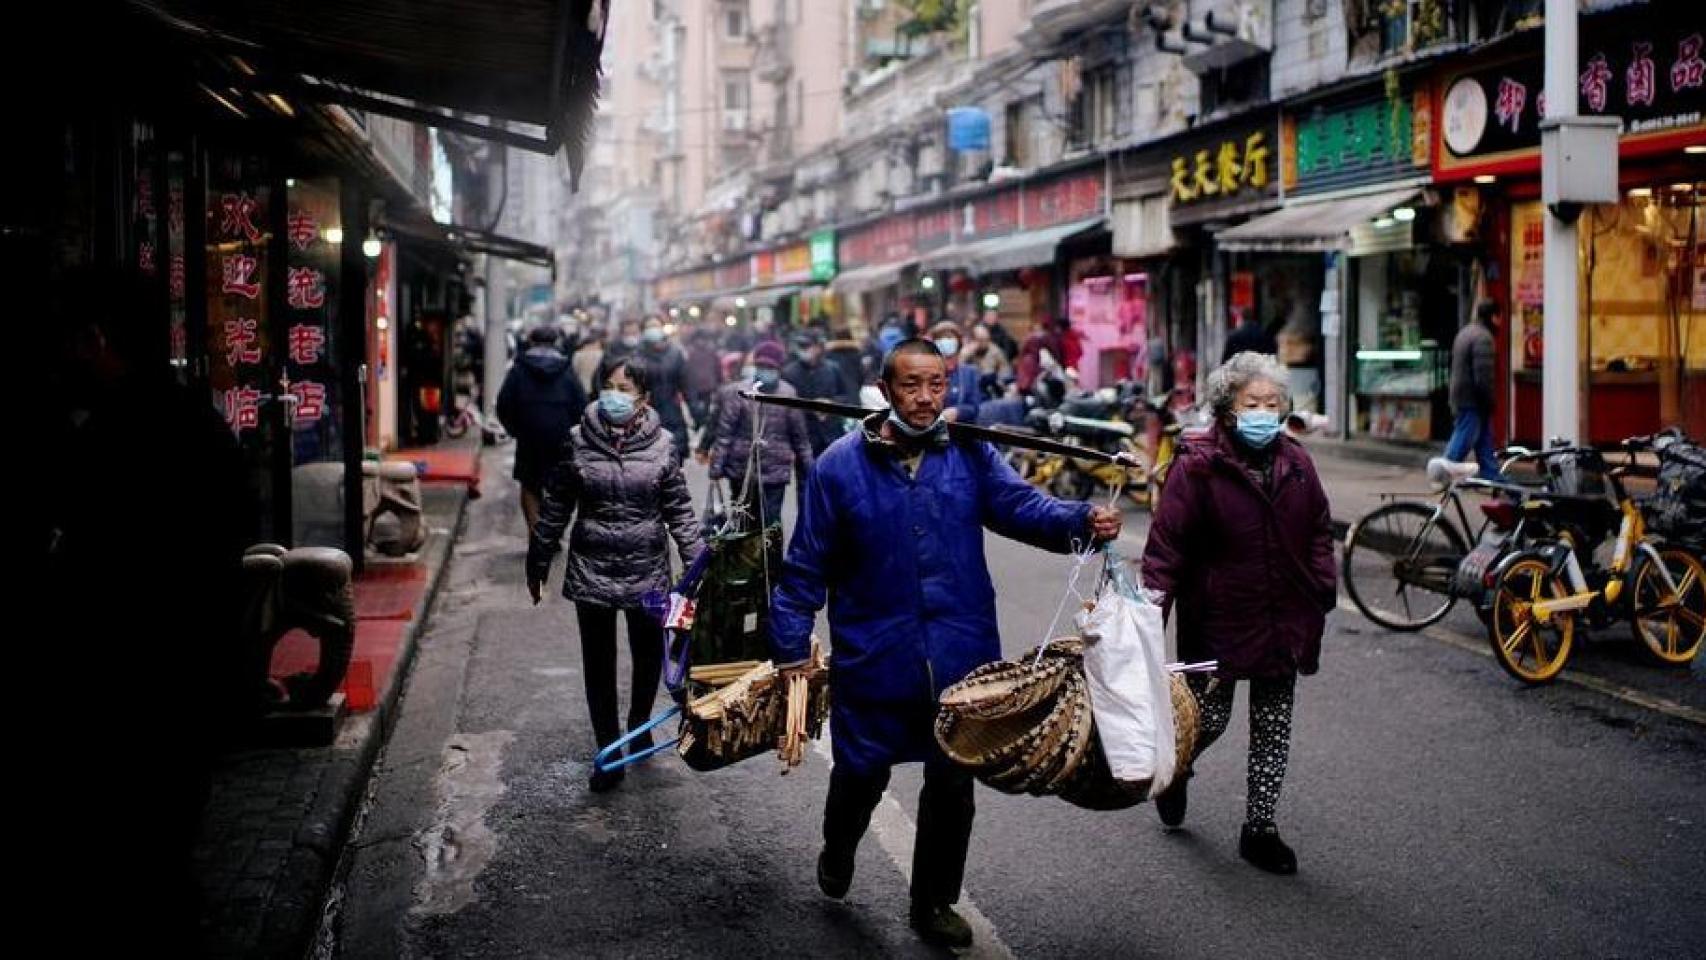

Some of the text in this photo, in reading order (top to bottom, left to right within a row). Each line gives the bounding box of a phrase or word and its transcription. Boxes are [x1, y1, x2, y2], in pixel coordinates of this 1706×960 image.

[1170, 131, 1269, 200] 天天餐厅
[221, 192, 262, 427] 欢迎光临
